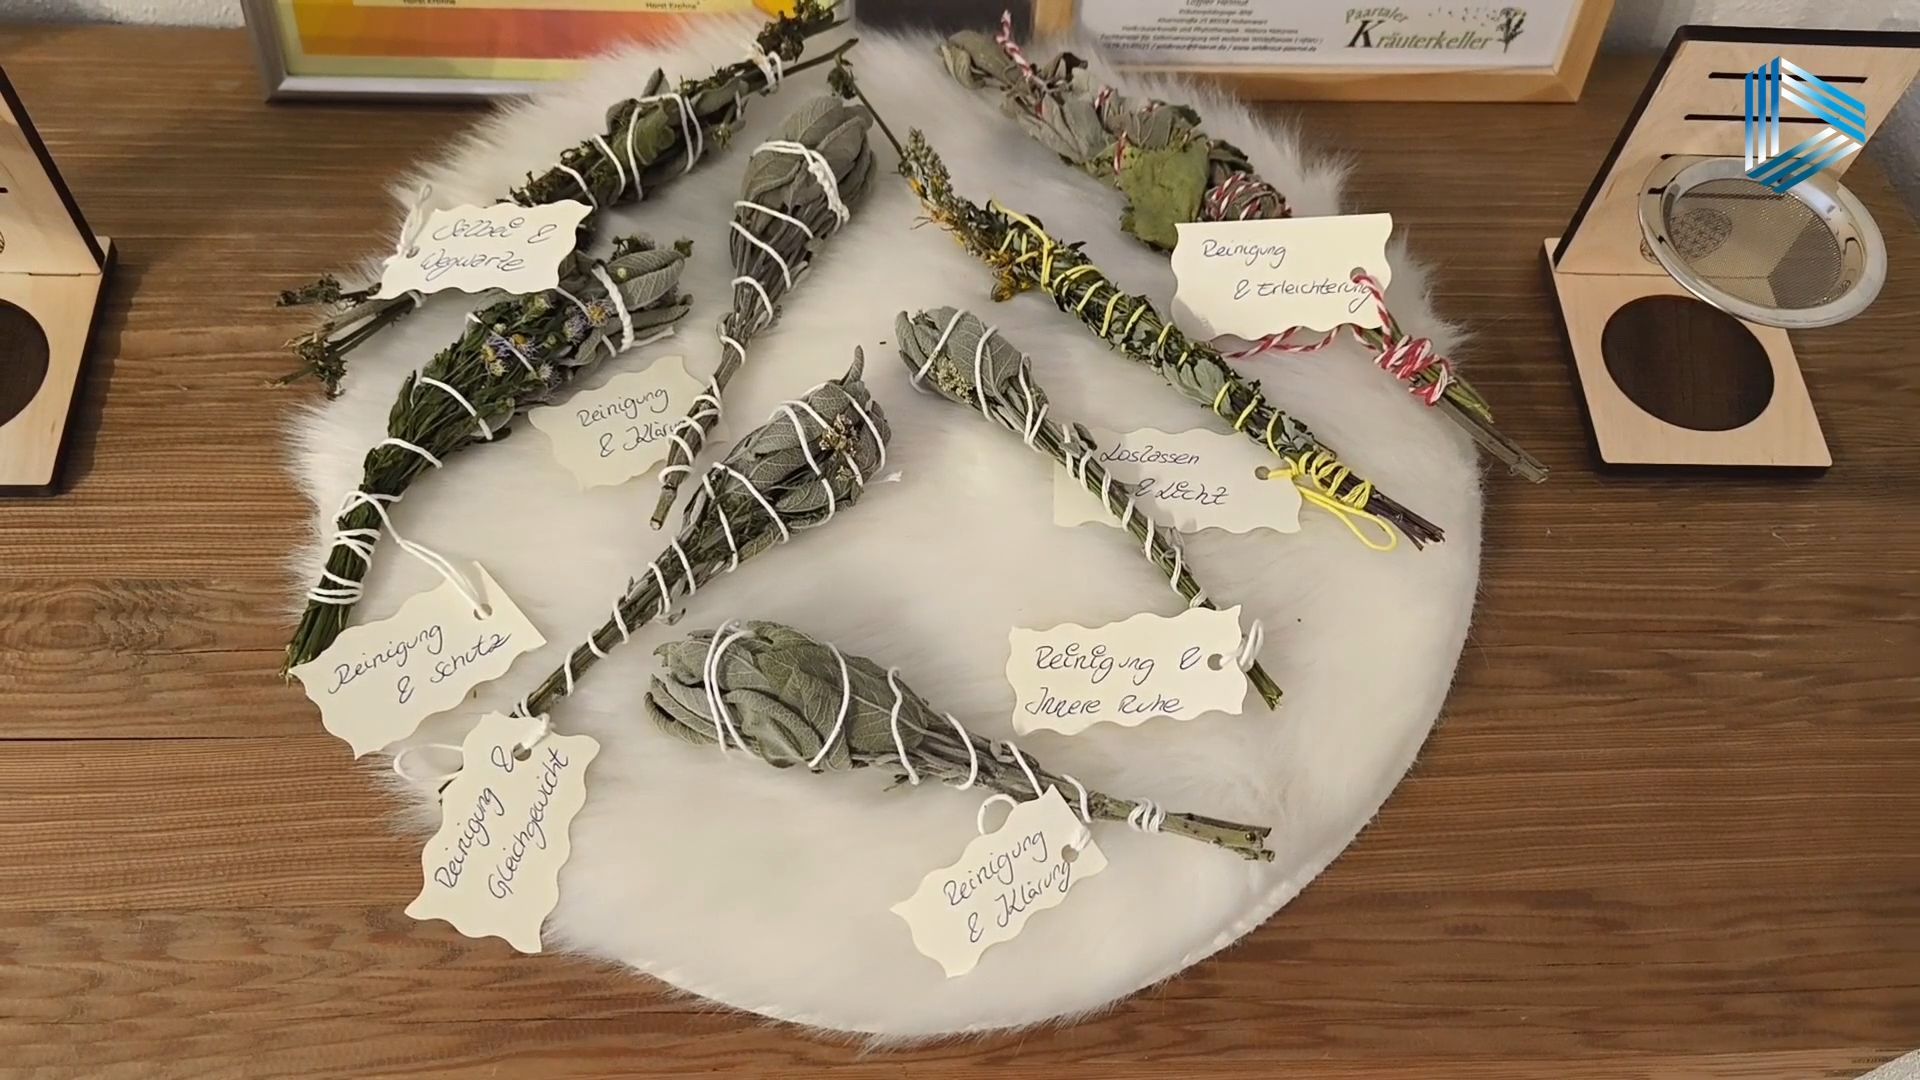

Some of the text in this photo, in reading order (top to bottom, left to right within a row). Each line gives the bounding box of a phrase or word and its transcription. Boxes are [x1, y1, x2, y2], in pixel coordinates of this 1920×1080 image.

[1345, 6, 1409, 24] Paartaler
[1344, 19, 1493, 50] Kräuterkeller
[1202, 239, 1287, 270] Reinigung
[1233, 277, 1372, 314] & Erleichterung
[576, 388, 670, 428] Reinigung
[599, 432, 616, 458] &
[1099, 442, 1201, 466] Loslassen
[328, 624, 444, 695] Reinigung
[1034, 642, 1203, 686] Reinigung &
[396, 675, 415, 705] &
[1024, 686, 1185, 718] Innere Ruhe
[433, 744, 515, 889] Reinigung &
[487, 746, 570, 900] Gleichgewicht
[942, 830, 1048, 906] Reinigung
[967, 861, 1071, 943] & Klärung
